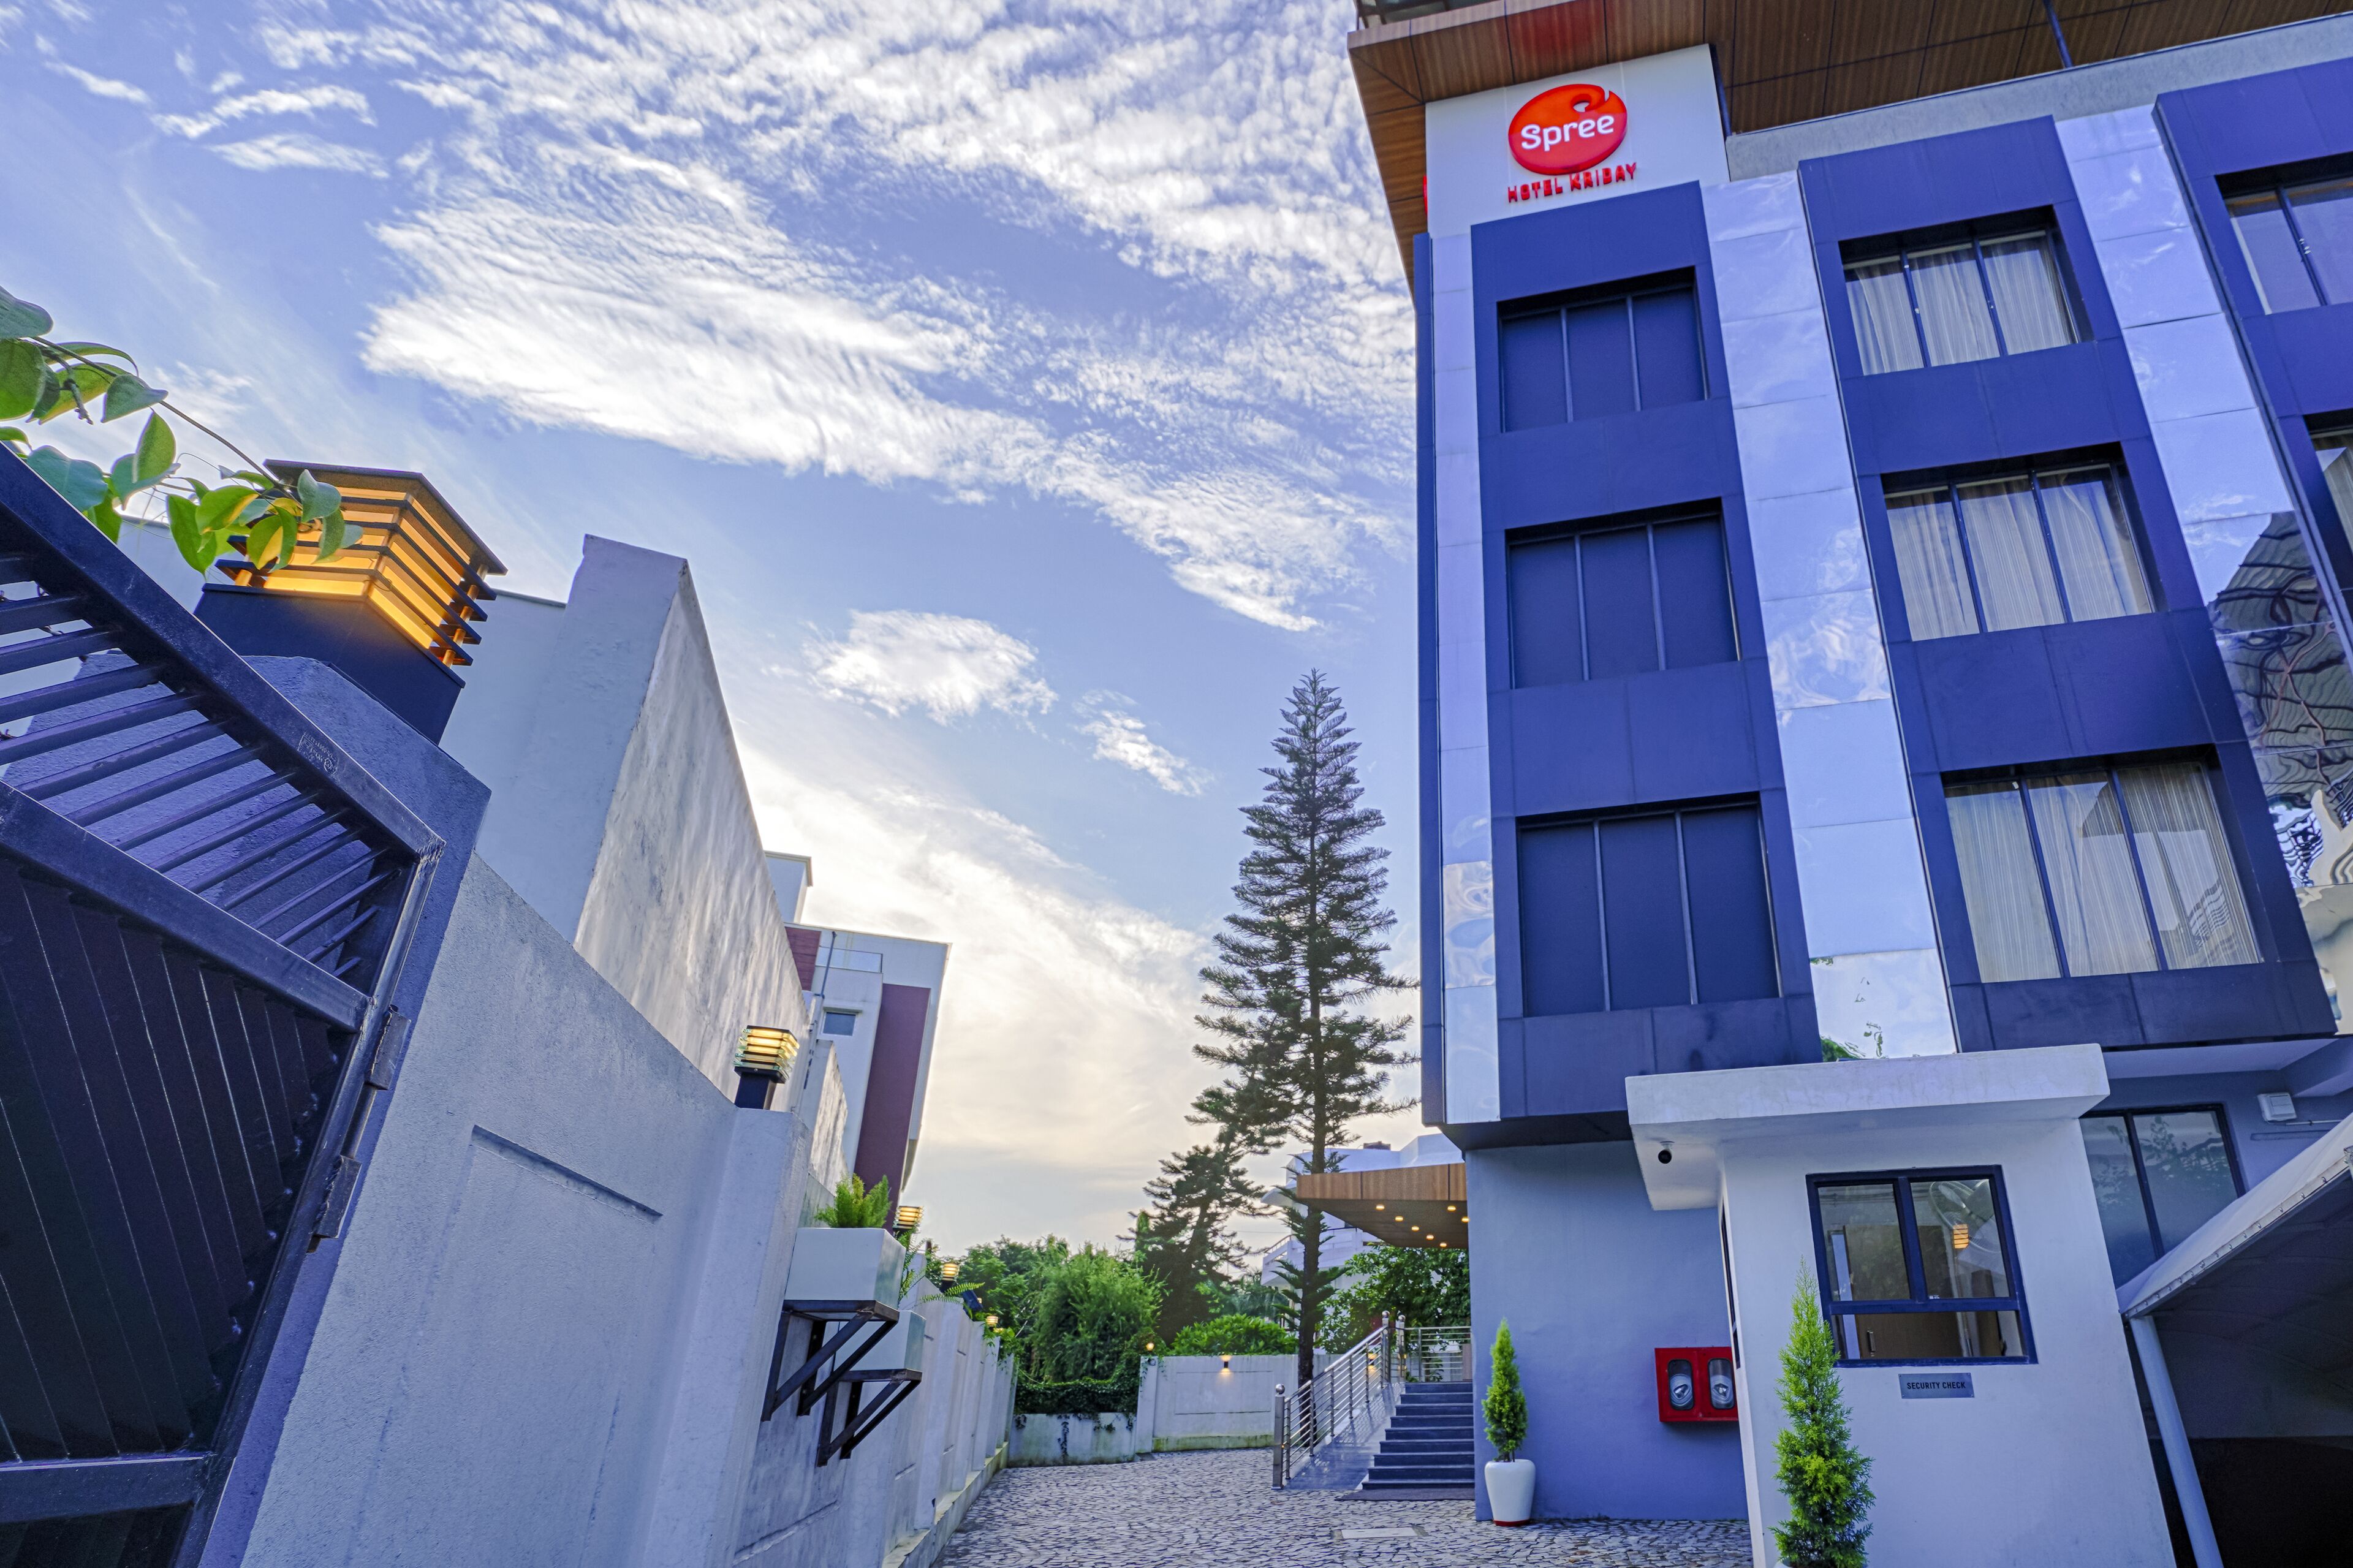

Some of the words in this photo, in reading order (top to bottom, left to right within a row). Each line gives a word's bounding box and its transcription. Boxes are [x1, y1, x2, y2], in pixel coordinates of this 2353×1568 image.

[1521, 115, 1615, 151] Spree
[1507, 177, 1563, 203] HOTEL
[1571, 162, 1637, 192] KRIDAY
